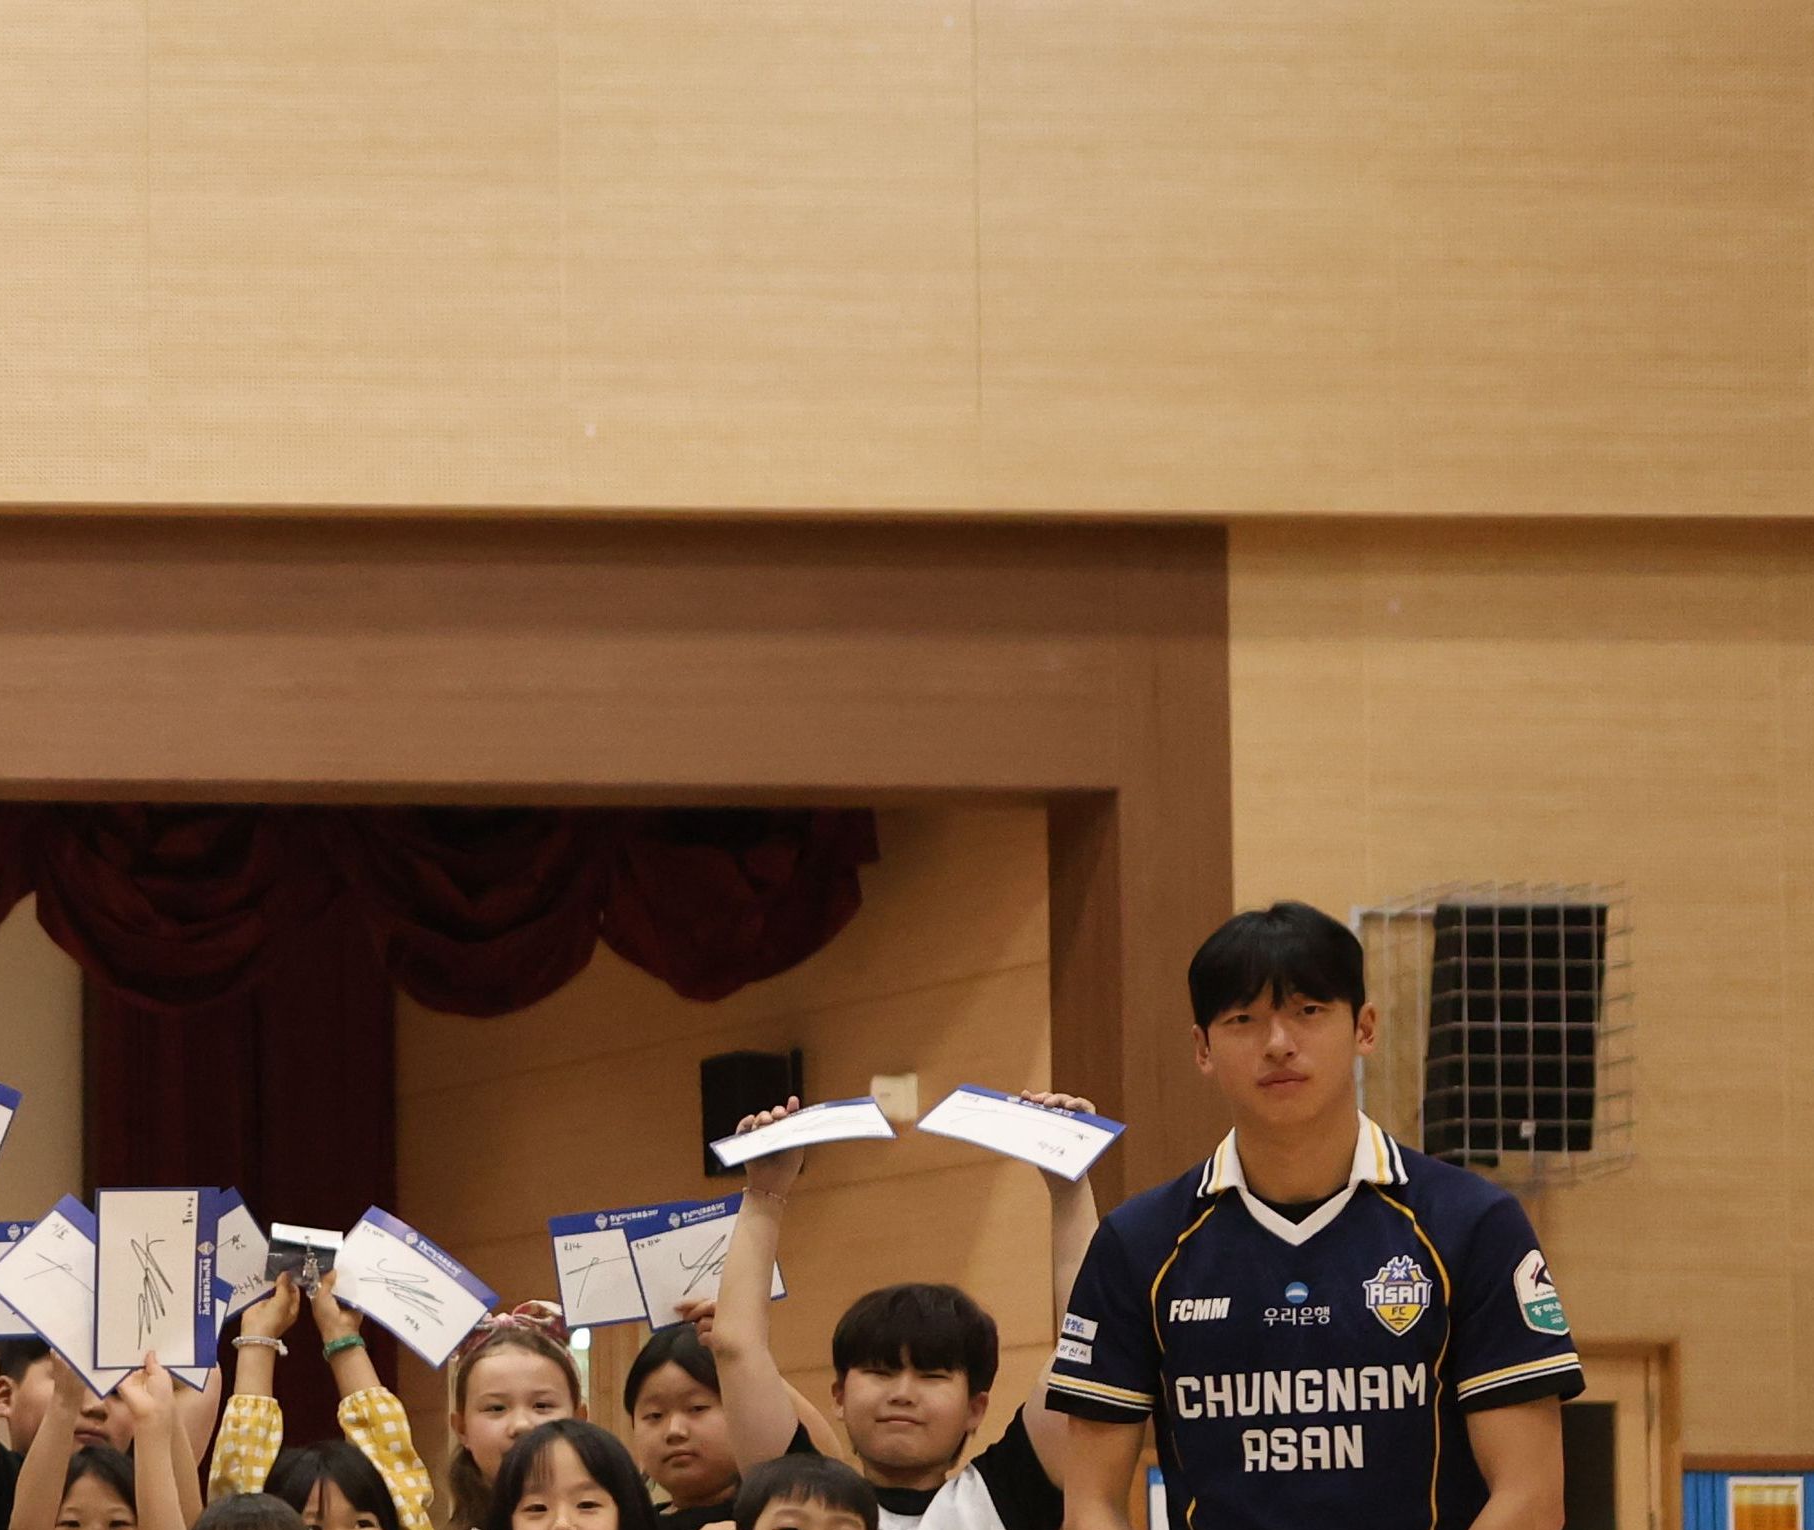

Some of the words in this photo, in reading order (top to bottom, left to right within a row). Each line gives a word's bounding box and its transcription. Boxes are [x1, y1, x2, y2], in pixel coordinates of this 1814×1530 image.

[1370, 1281, 1428, 1304] ASAN
[1169, 1297, 1231, 1323] FCMM
[1263, 1306, 1331, 1327] 우리은행
[1392, 1305, 1407, 1316] FC
[1175, 1362, 1427, 1420] CHUNGNAM
[1244, 1425, 1364, 1473] ASAN
